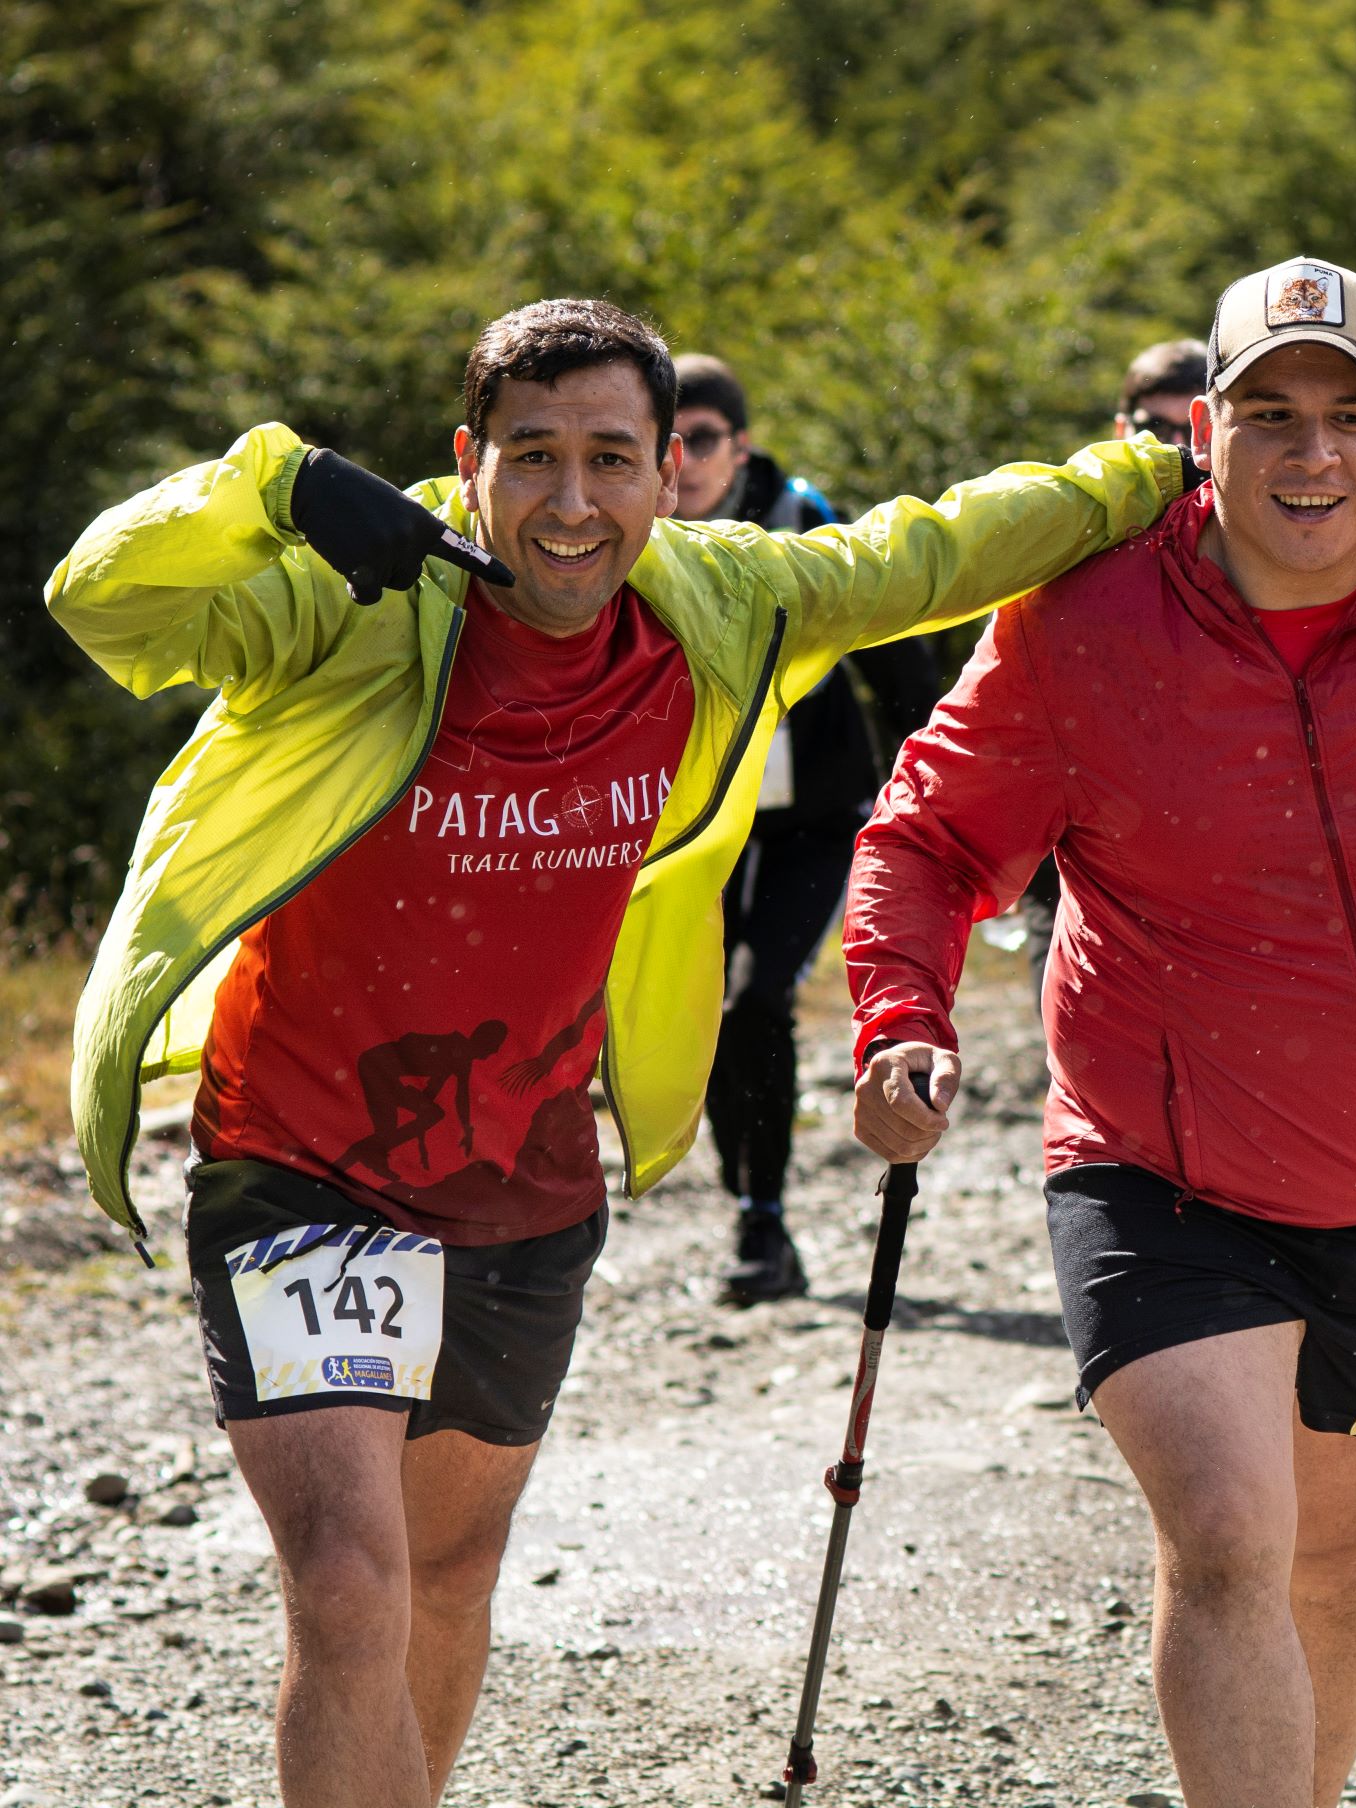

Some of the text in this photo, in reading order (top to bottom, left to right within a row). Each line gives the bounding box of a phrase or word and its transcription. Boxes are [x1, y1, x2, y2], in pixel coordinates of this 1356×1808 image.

[1314, 267, 1333, 276] PUMA
[448, 839, 643, 874] TRAIL RUNNERS
[283, 1275, 404, 1339] 142
[354, 1370, 393, 1381] MAGALLANES
